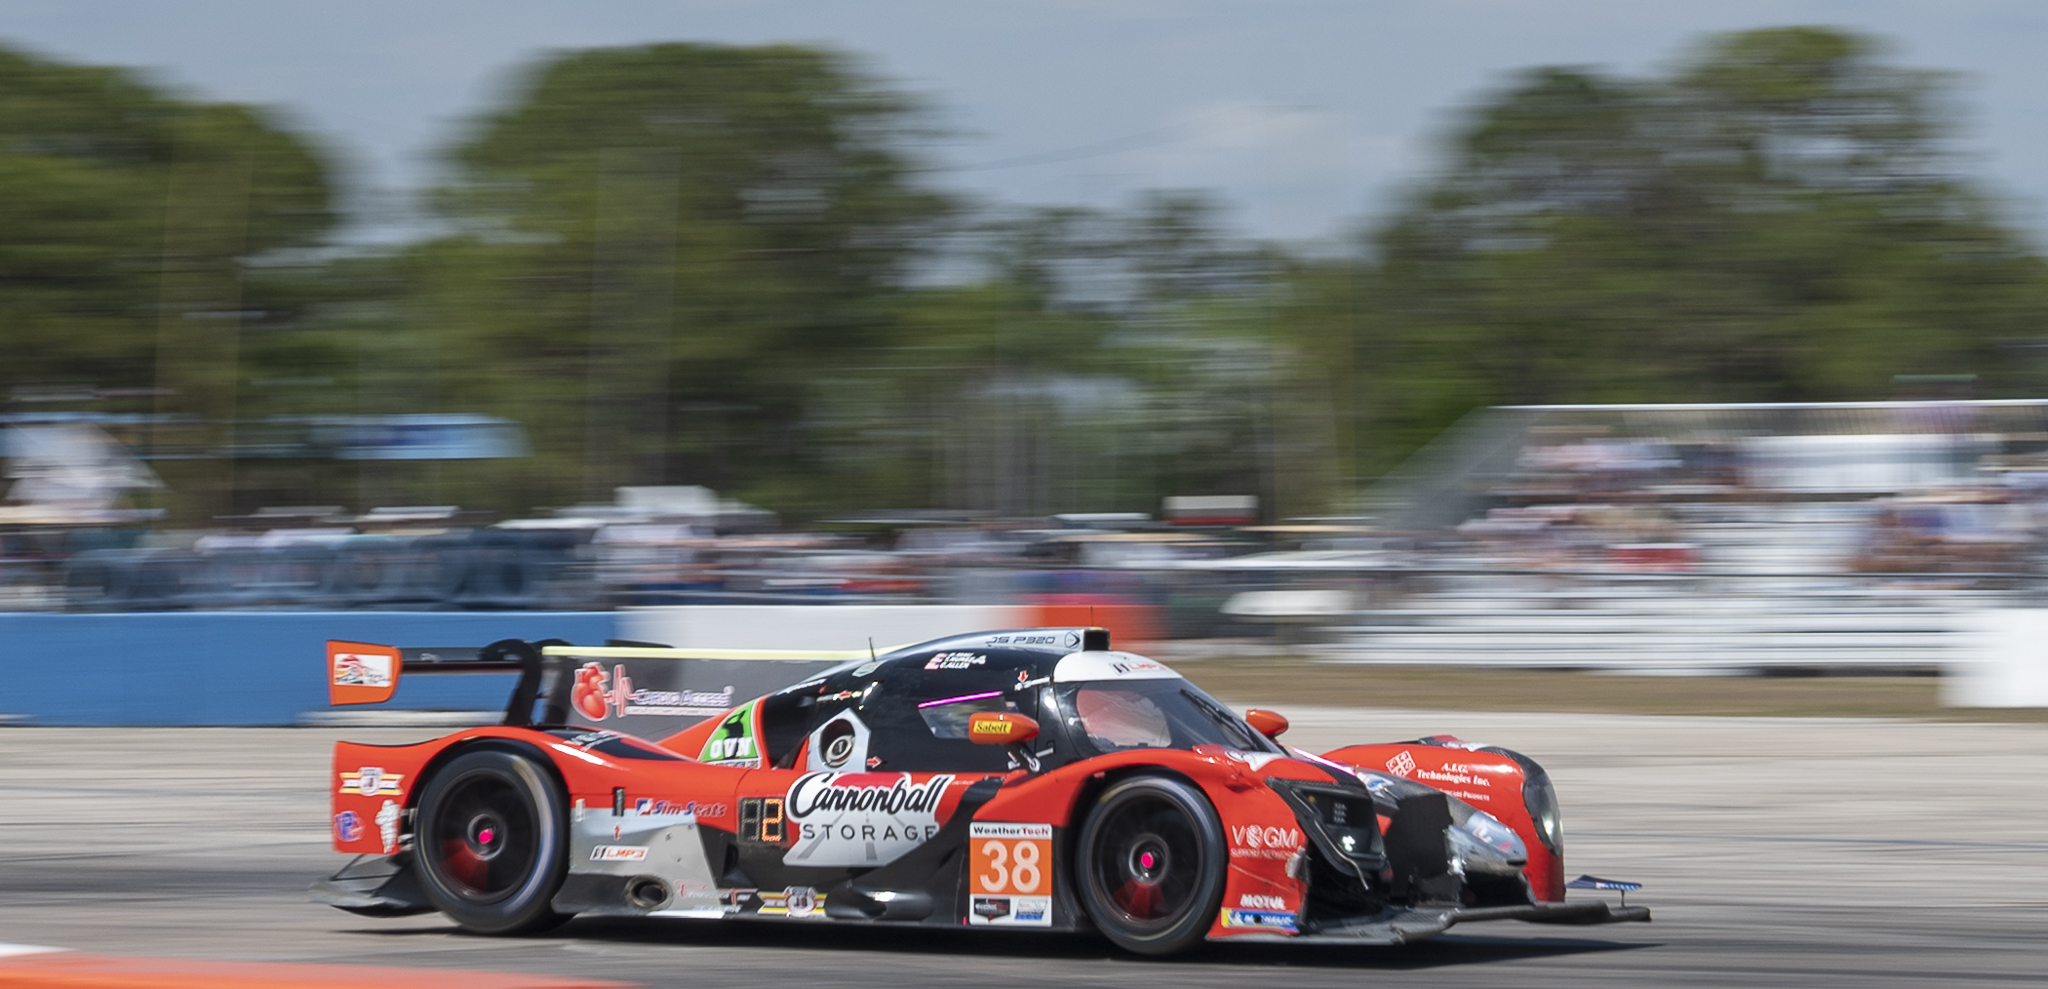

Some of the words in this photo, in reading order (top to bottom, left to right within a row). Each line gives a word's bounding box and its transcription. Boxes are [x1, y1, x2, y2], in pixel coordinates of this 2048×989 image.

[1013, 636, 1056, 645] P320
[976, 722, 1008, 732] Sabelt
[709, 736, 753, 759] OVN
[1416, 769, 1471, 785] Technologies
[1473, 775, 1491, 787] Inc.
[790, 772, 950, 818] Cannonball
[652, 799, 682, 815] Sim
[683, 801, 727, 817] Seats
[803, 824, 937, 842] STORAGE
[973, 826, 1049, 836] WeatherTech
[606, 848, 645, 858] LMP3
[980, 840, 1041, 893] 38
[1240, 893, 1286, 910] MOTUL
